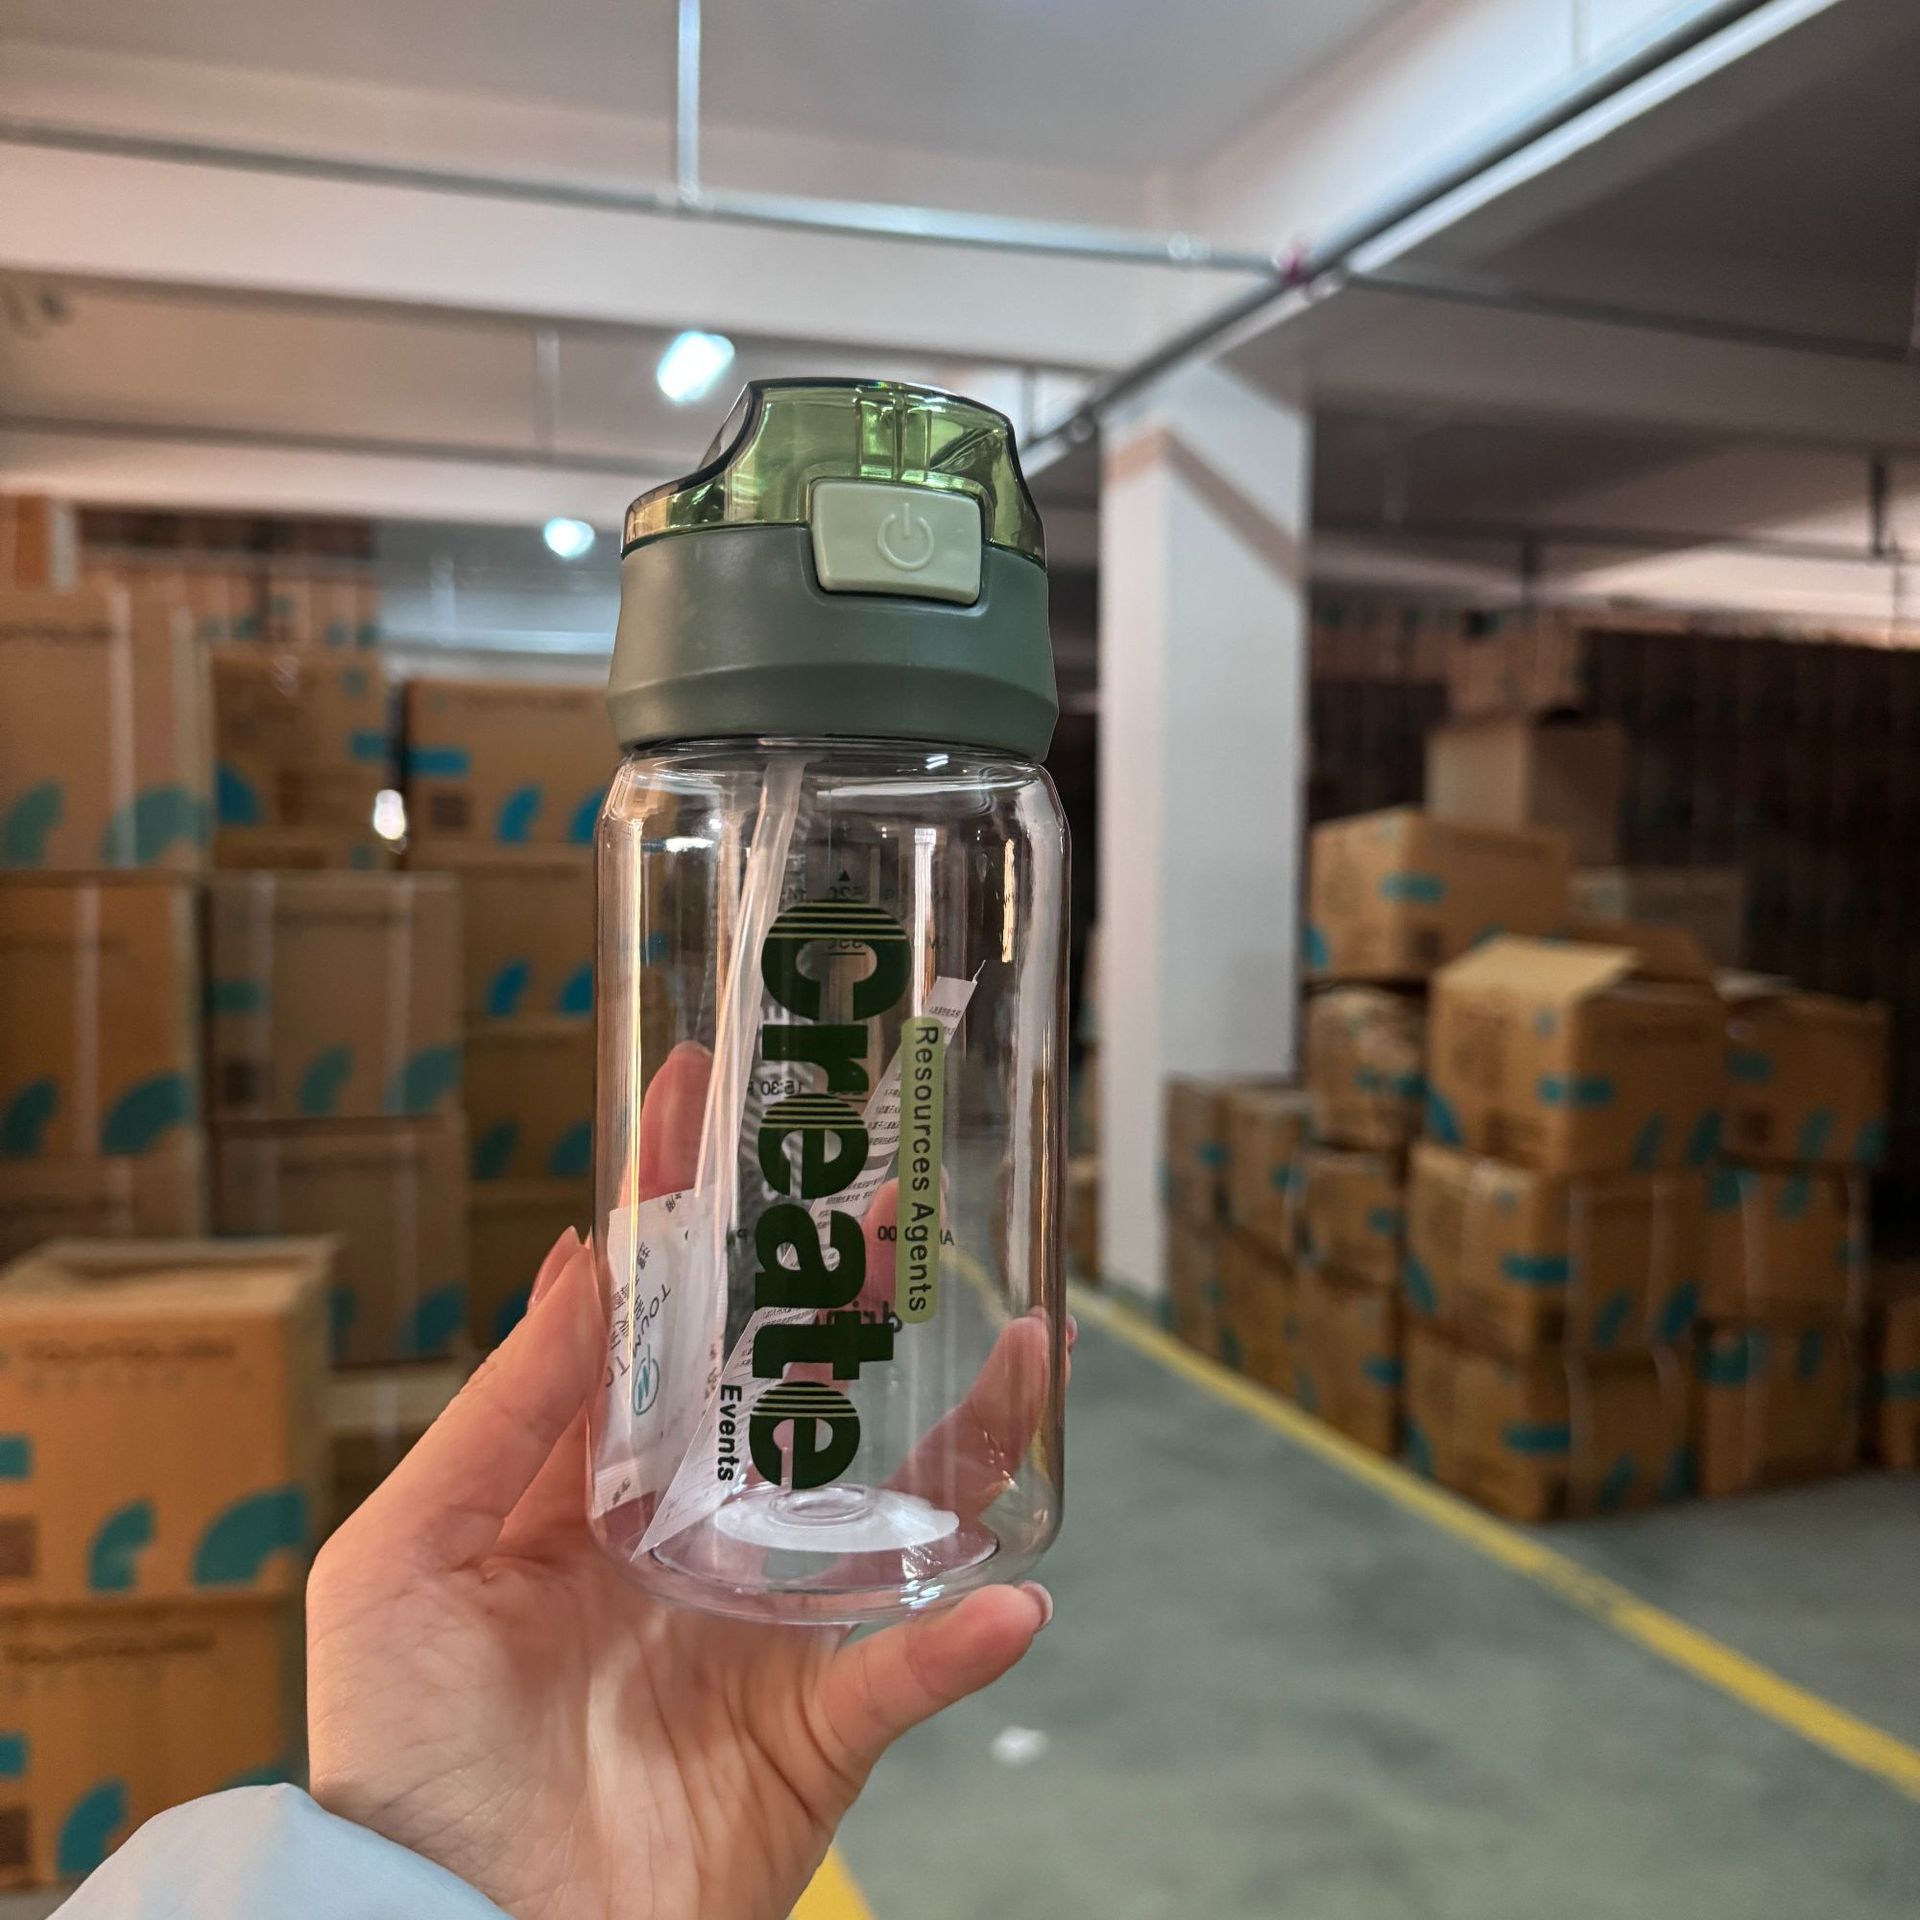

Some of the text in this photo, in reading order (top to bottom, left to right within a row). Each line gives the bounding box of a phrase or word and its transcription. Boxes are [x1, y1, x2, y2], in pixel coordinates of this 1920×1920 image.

[748, 899, 912, 1490] Create
[904, 1025, 939, 1312] Resources Agents
[717, 1385, 742, 1482] Events
